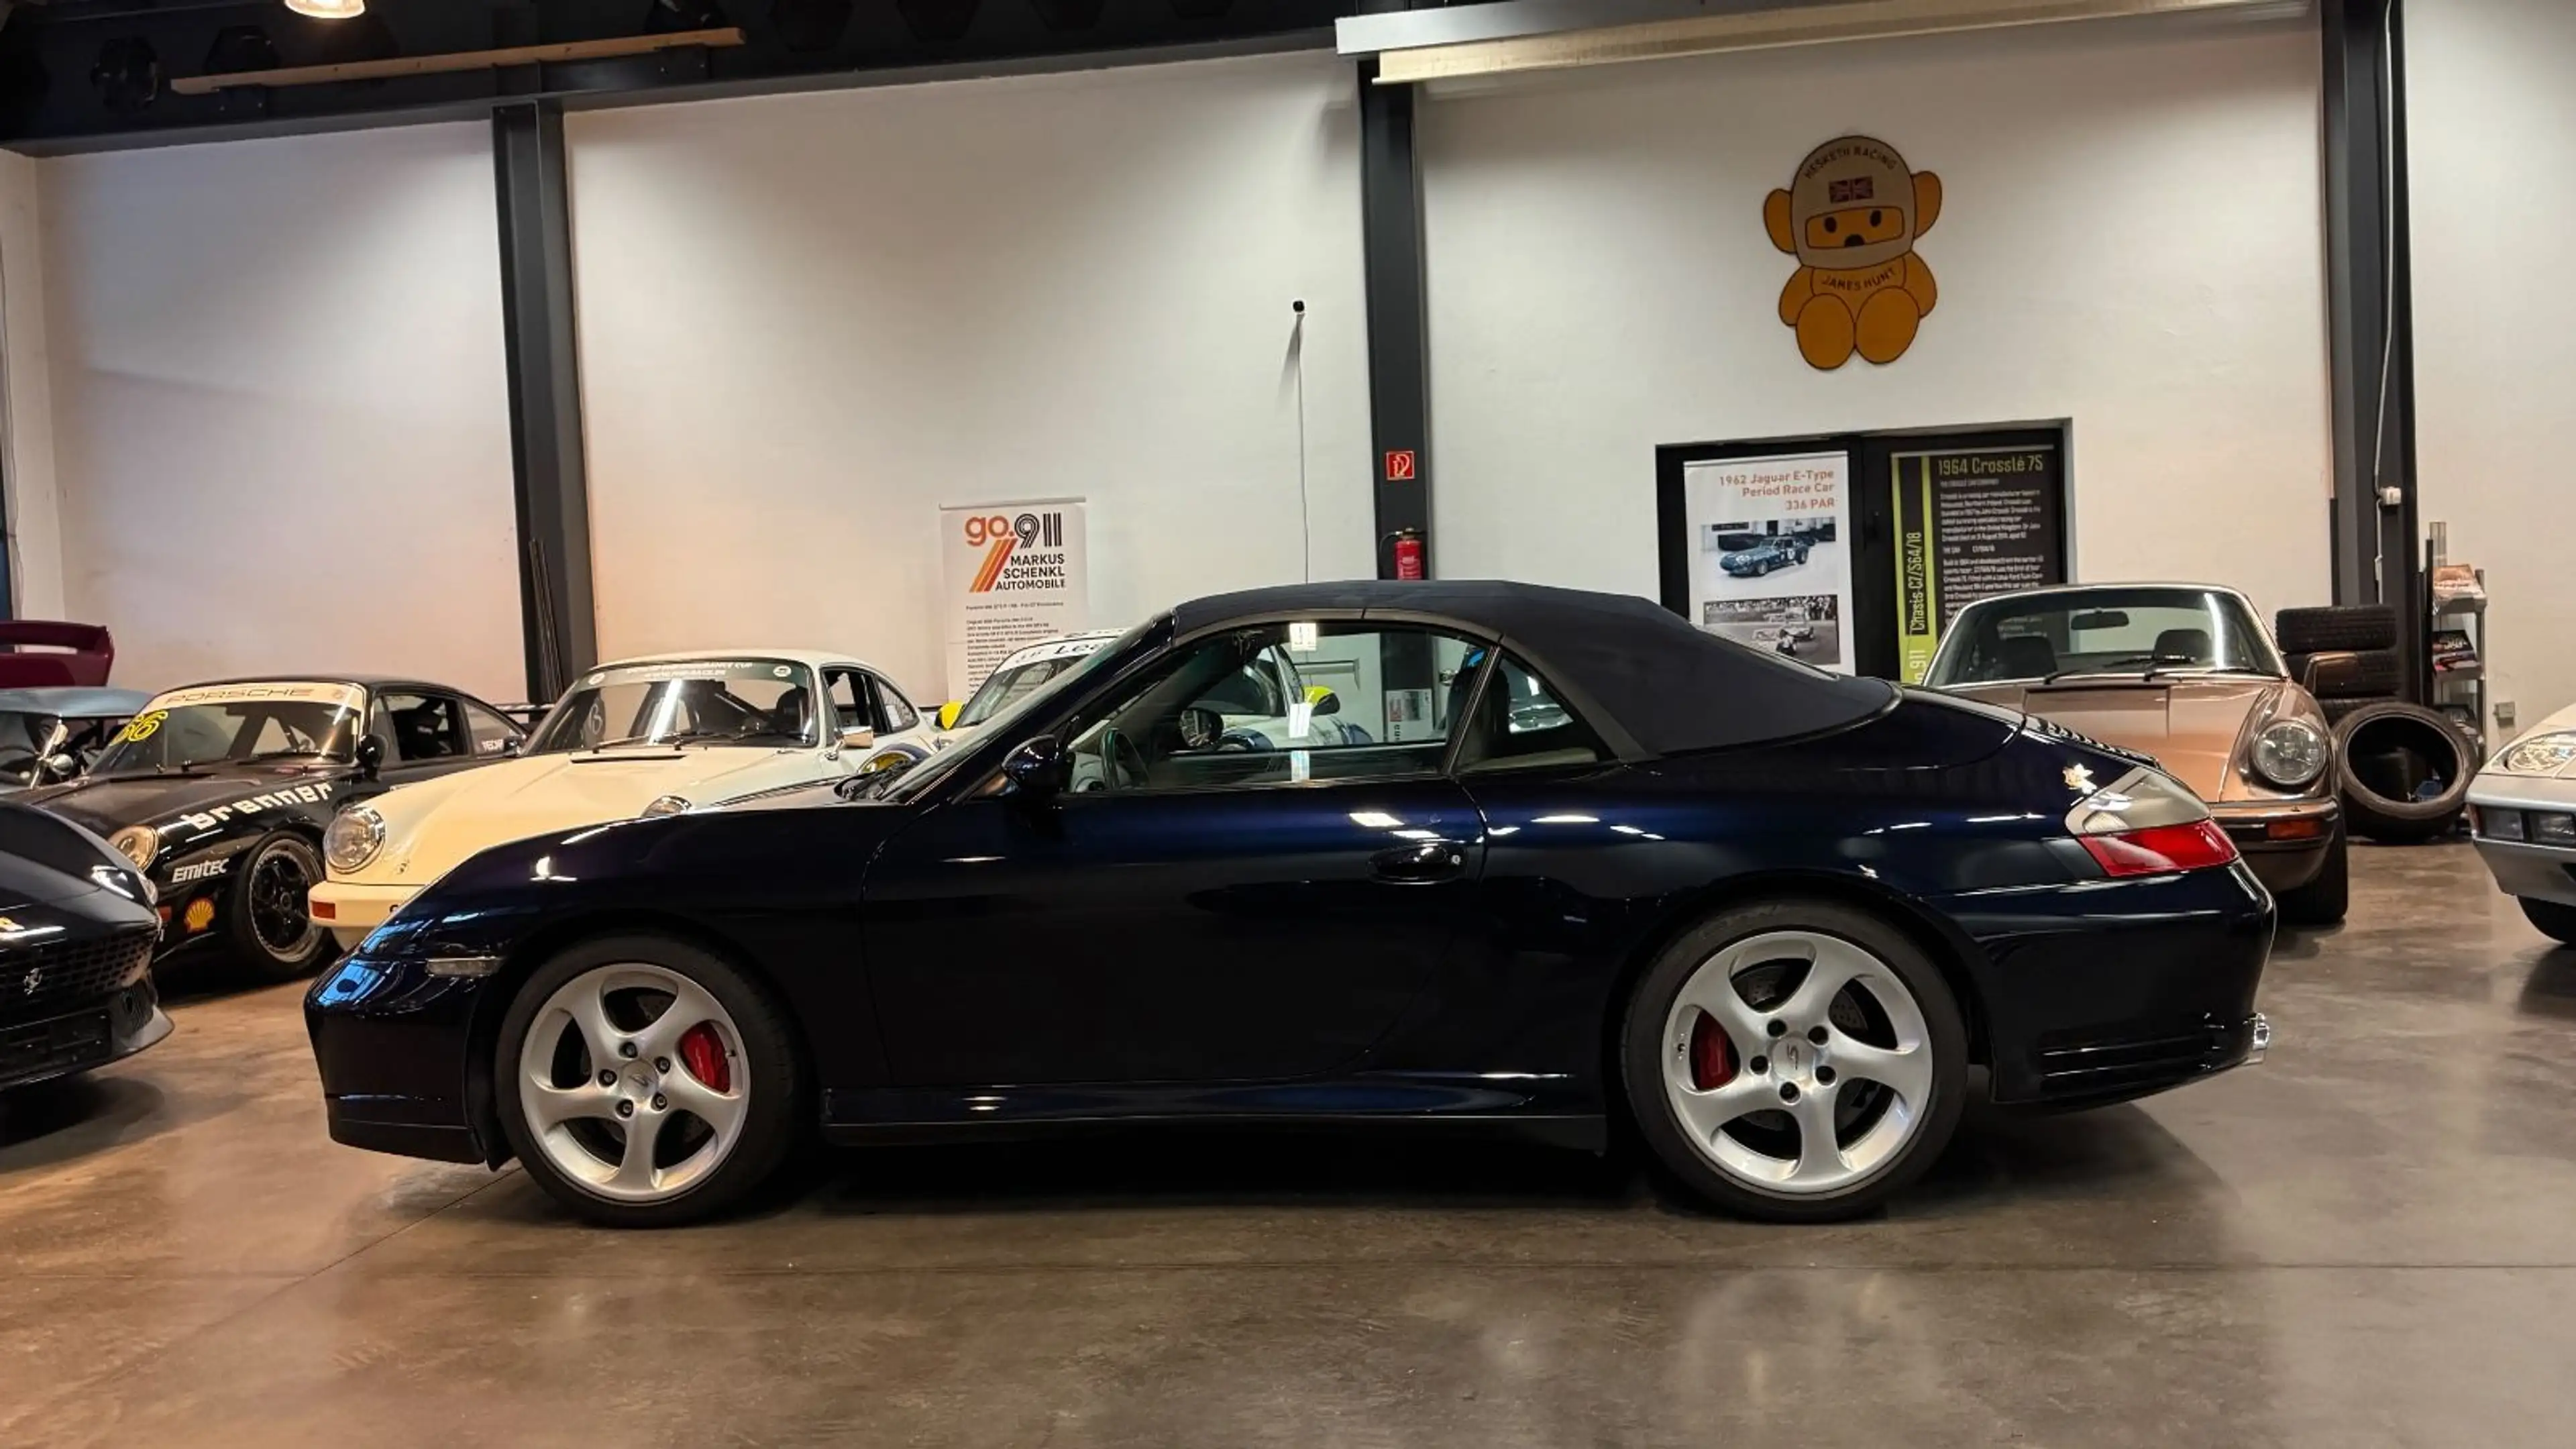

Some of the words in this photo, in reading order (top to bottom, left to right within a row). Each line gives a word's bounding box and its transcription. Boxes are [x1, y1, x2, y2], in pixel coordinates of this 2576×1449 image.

[1854, 146, 1897, 170] RACING
[1821, 275, 1861, 291] JAMES
[1864, 268, 1896, 288] HUNT
[1938, 458, 1968, 476] 1964
[1719, 474, 1747, 486] 1962
[1750, 472, 1790, 484] Jaguar
[1793, 469, 1834, 482] E-Type
[1742, 484, 1780, 497] Period
[1783, 484, 1811, 494] Race
[1814, 482, 1835, 492] Car
[1786, 500, 1807, 511] 336
[1811, 497, 1835, 508] PAR
[1010, 553, 1065, 566] MARKUS
[1004, 566, 1065, 579] SCHENKL
[995, 578, 1065, 591] AUTOMOBILE
[165, 688, 315, 705] PORSCHE
